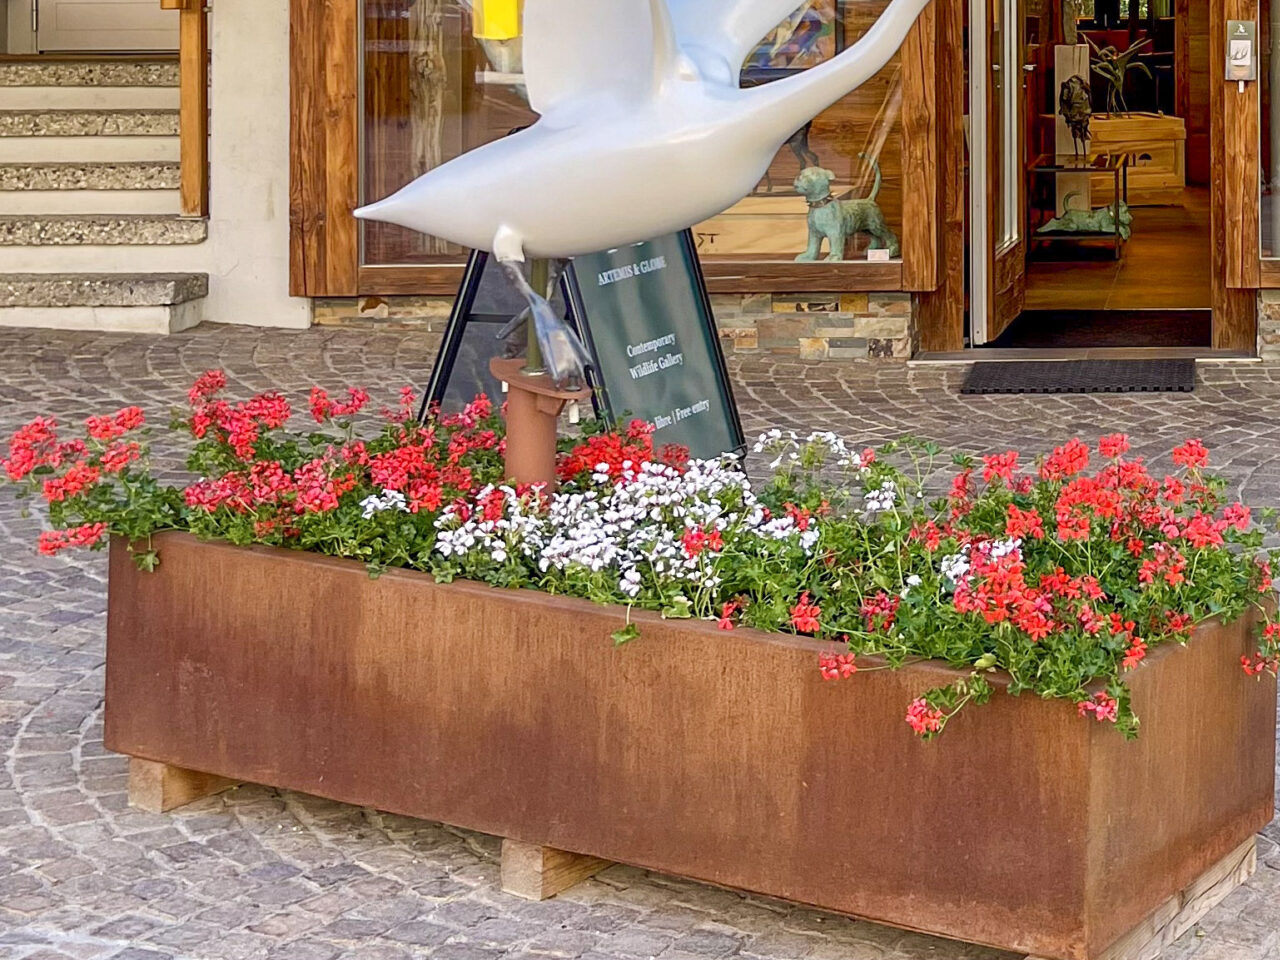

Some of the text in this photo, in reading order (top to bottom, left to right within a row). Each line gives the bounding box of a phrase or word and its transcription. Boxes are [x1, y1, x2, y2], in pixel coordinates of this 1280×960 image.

[597, 264, 634, 286] ARTEMIS
[640, 255, 667, 274] GLOBE
[626, 333, 676, 358] Contemporary
[629, 353, 683, 380] Wildlife Gallery
[675, 407, 692, 421] Free
